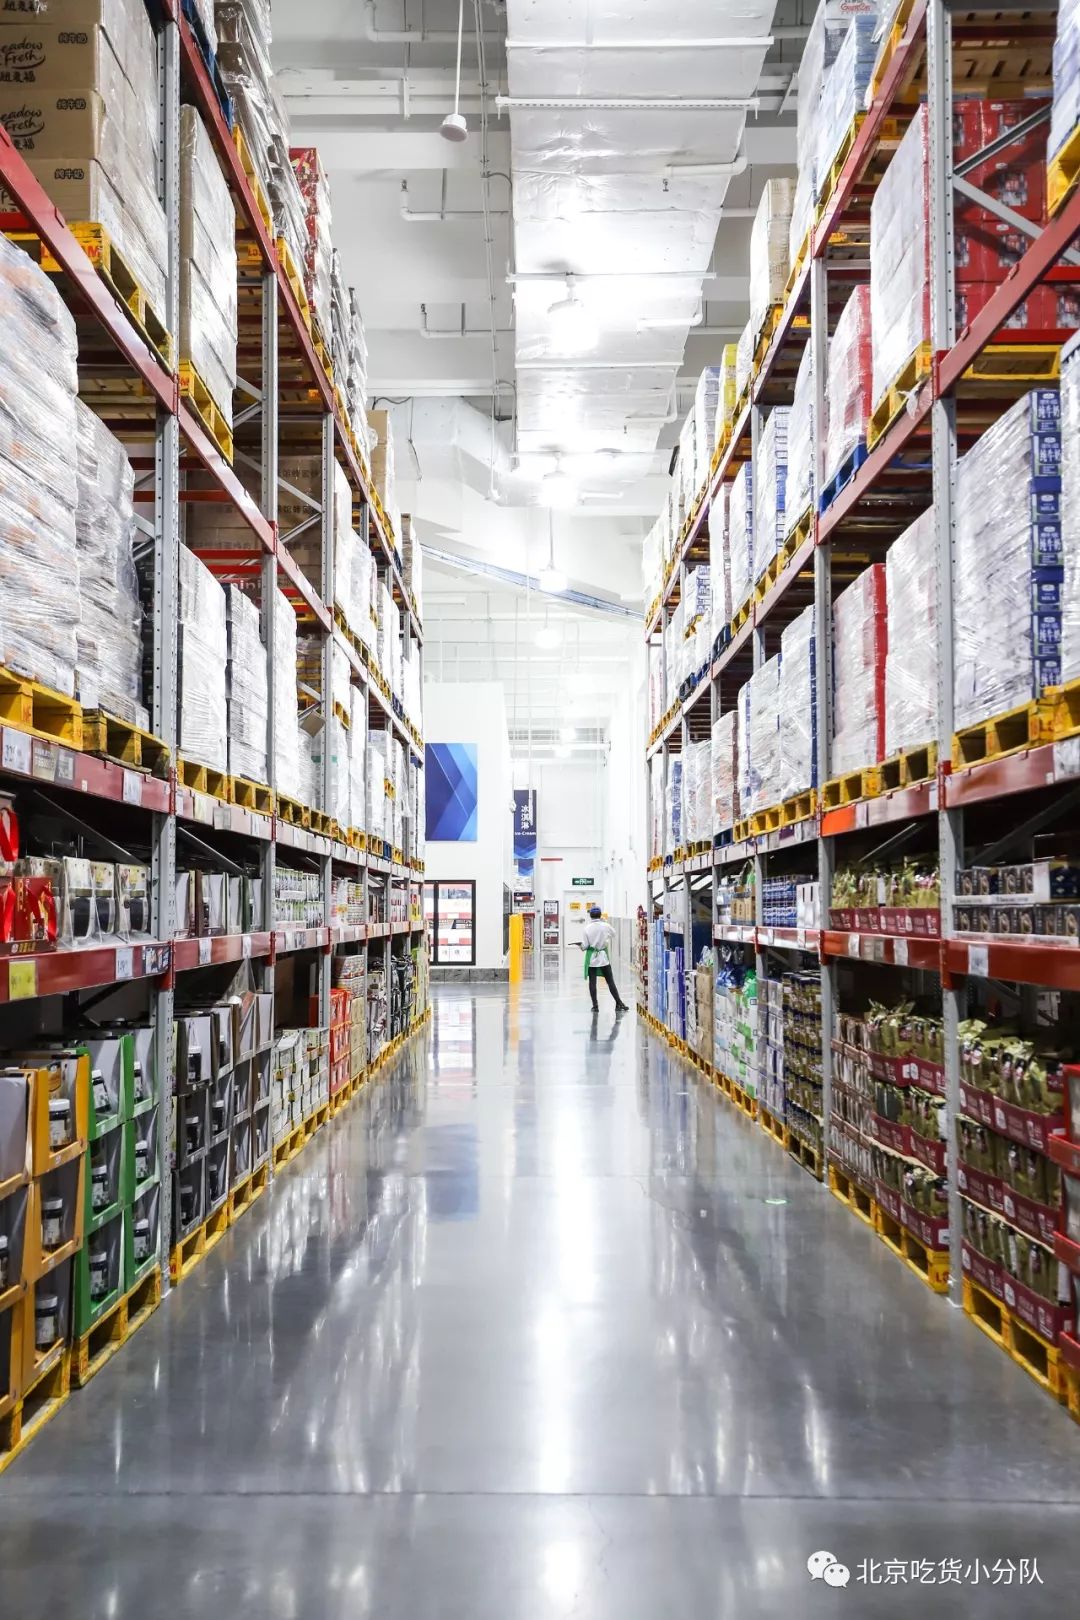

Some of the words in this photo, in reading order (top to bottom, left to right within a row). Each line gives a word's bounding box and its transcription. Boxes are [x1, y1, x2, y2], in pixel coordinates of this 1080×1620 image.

[0, 35, 43, 53] eadow
[5, 51, 39, 66] Fresh
[0, 104, 43, 121] eadow
